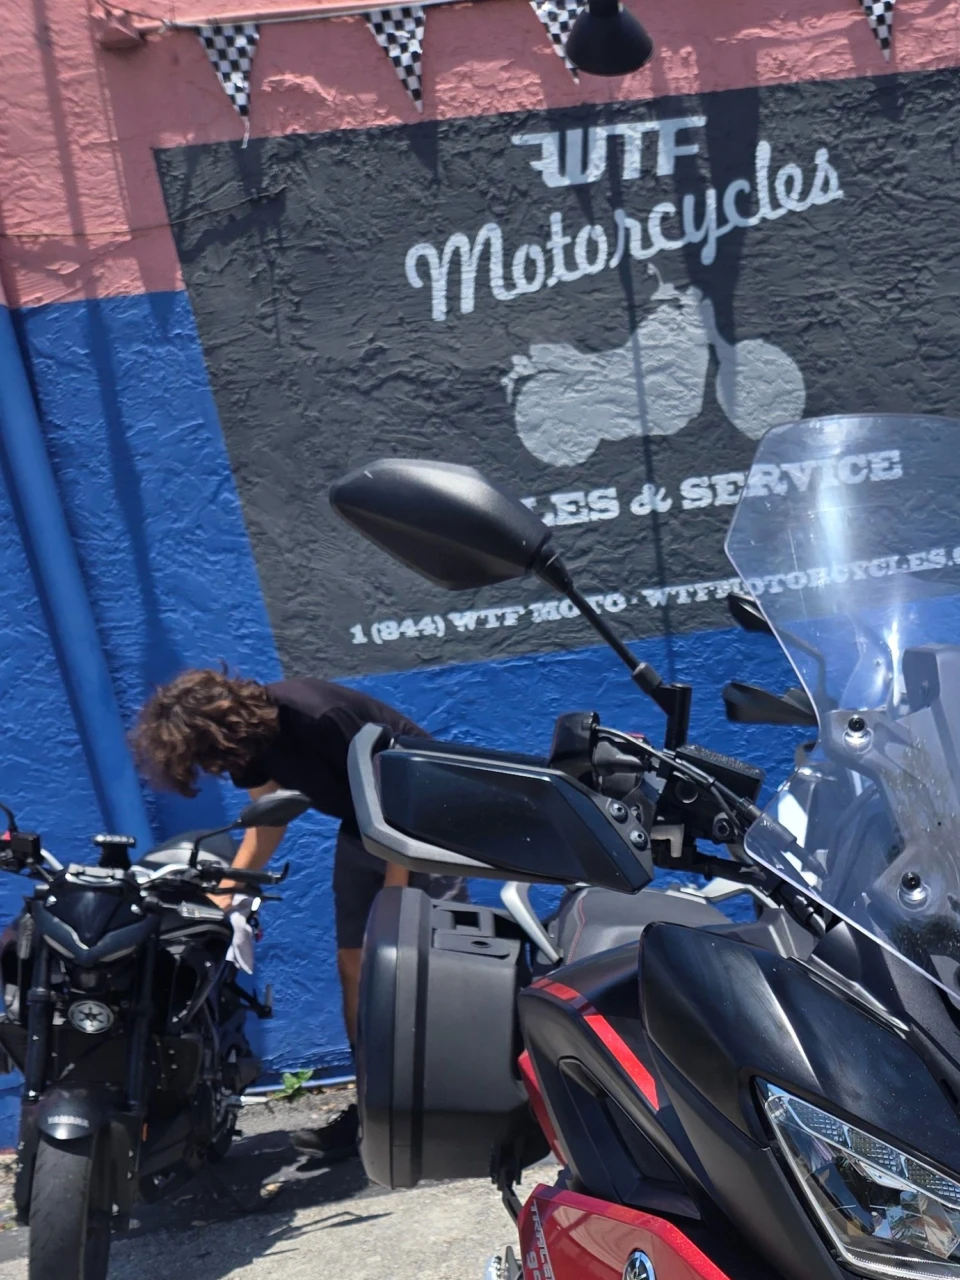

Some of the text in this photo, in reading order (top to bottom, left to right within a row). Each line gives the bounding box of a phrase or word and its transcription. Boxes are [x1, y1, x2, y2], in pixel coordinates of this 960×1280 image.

[511, 115, 707, 188] WTF
[404, 140, 844, 321] Motorcycles
[629, 483, 673, 516] &
[679, 449, 903, 510] SERVICE
[349, 623, 368, 644] 1
[370, 615, 446, 645] (844)
[448, 605, 526, 632] WTF
